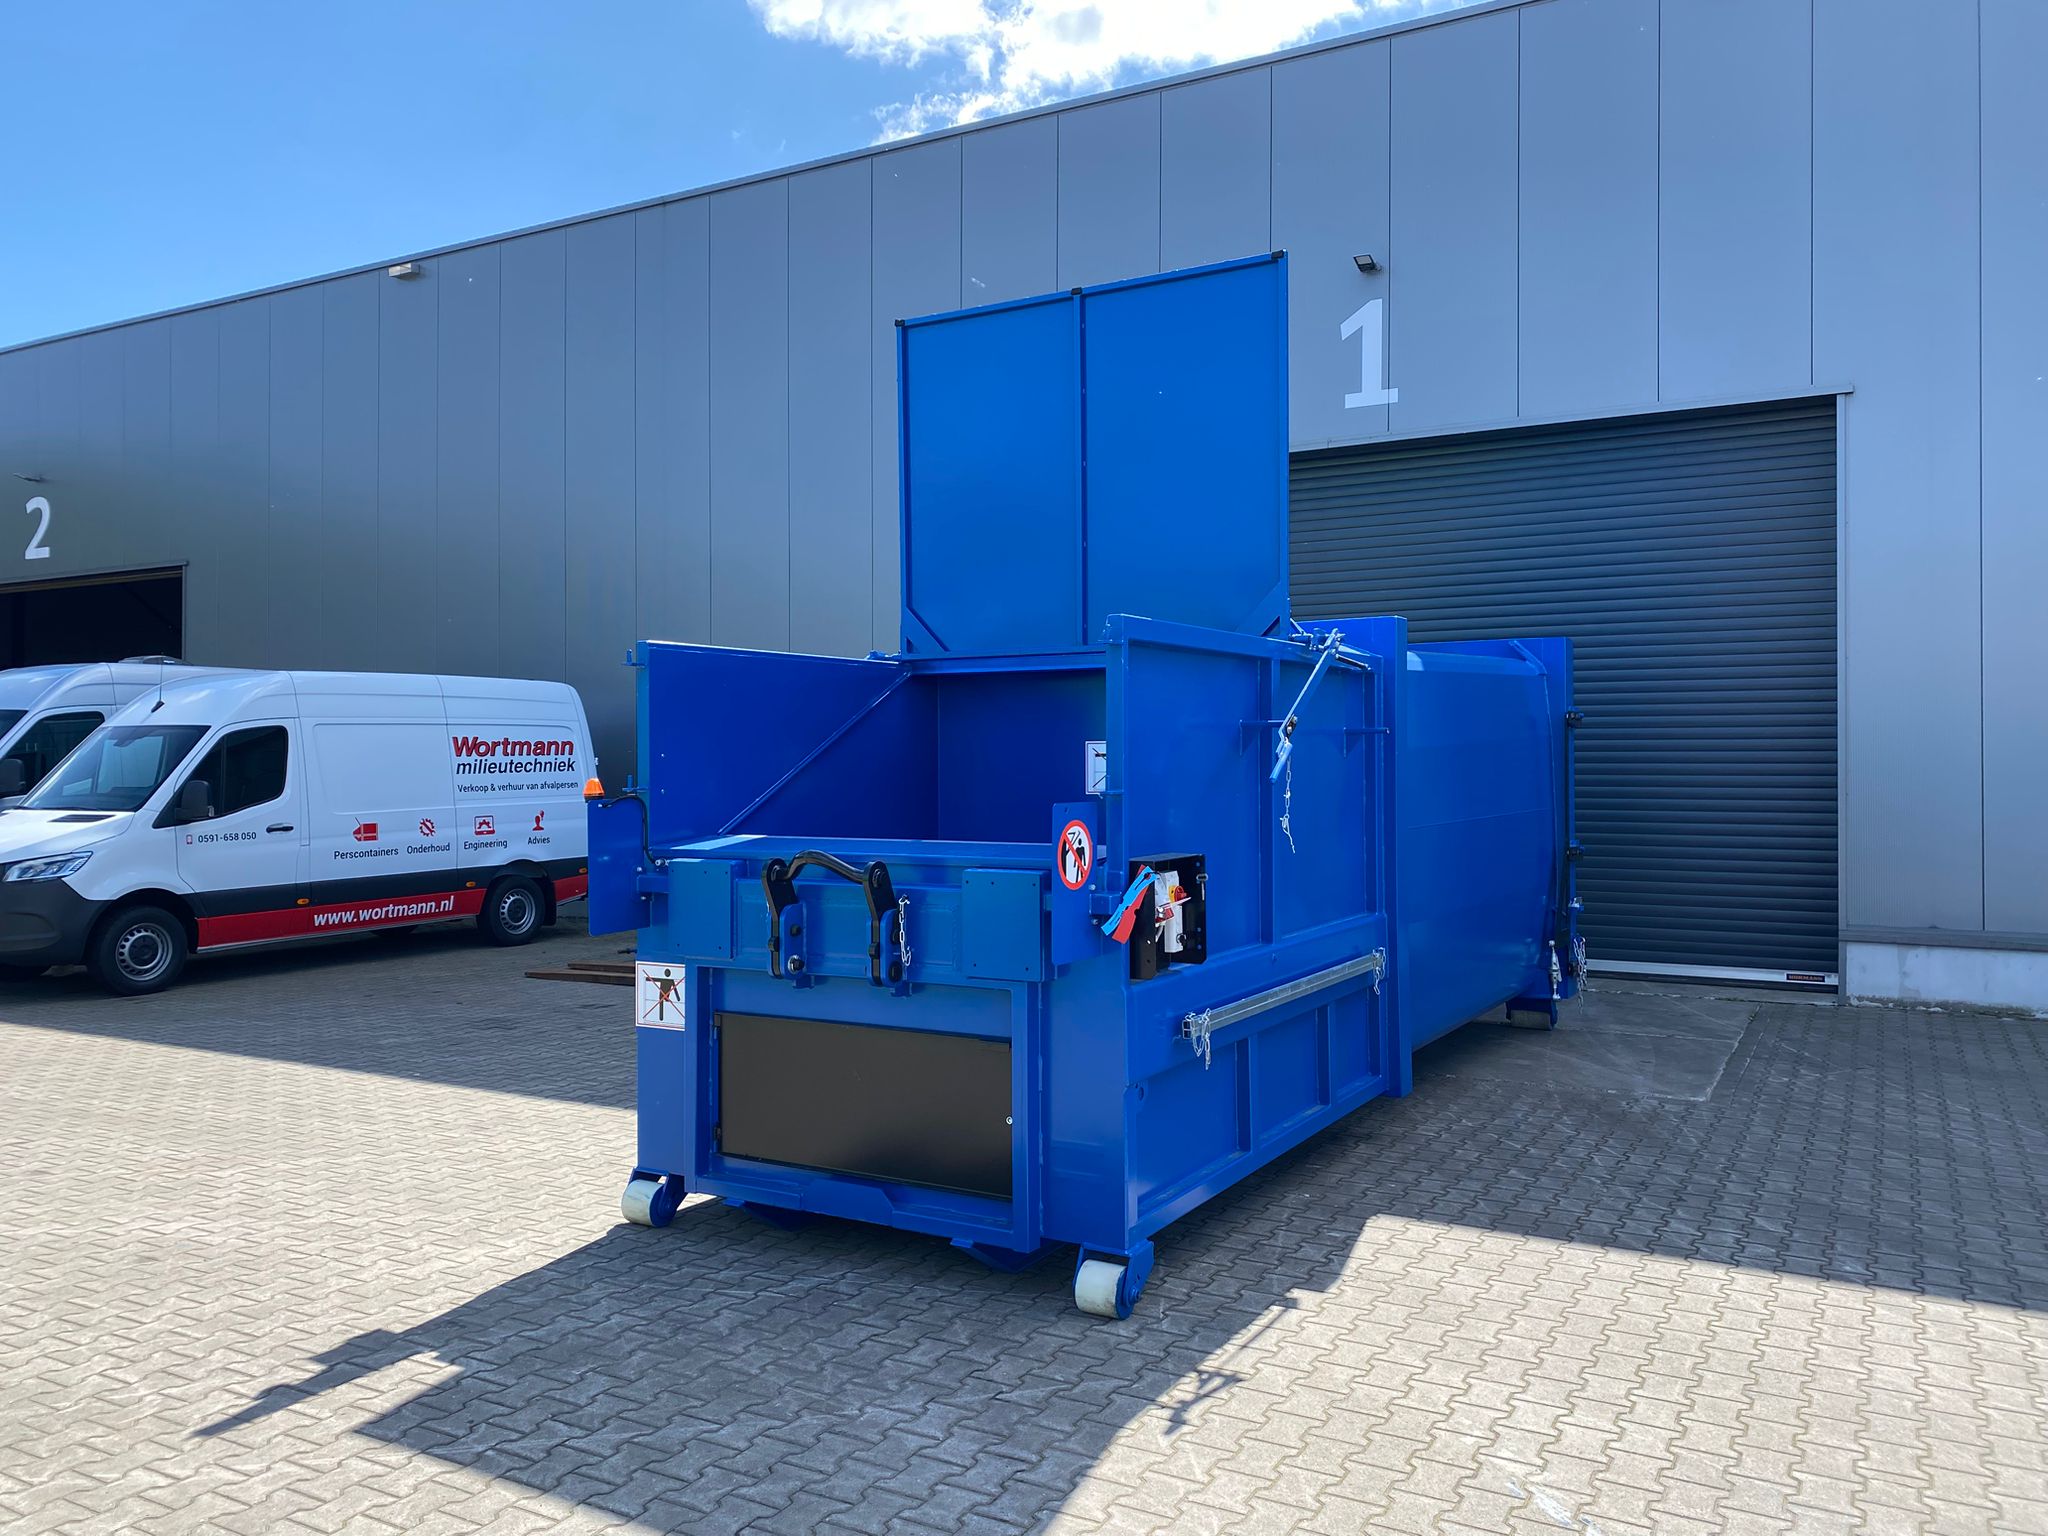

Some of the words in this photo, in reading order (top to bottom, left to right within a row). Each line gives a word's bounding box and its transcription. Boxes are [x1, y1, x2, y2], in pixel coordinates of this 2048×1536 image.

[1340, 299, 1398, 408] 1
[25, 496, 50, 560] 2
[452, 736, 574, 757] Wortmann
[456, 758, 576, 774] milieutechniek
[457, 783, 489, 793] Verkoop
[490, 783, 496, 791] &
[497, 782, 524, 791] verhuur
[540, 781, 579, 791] afvalpersen
[198, 832, 239, 843] 0591-658
[241, 831, 257, 840] 050
[527, 835, 550, 845] Advies
[406, 842, 450, 855] Onderhoud
[463, 838, 508, 851] Engineering
[333, 846, 399, 860] Perscontainers
[313, 895, 455, 926] www.wortmann.nl
